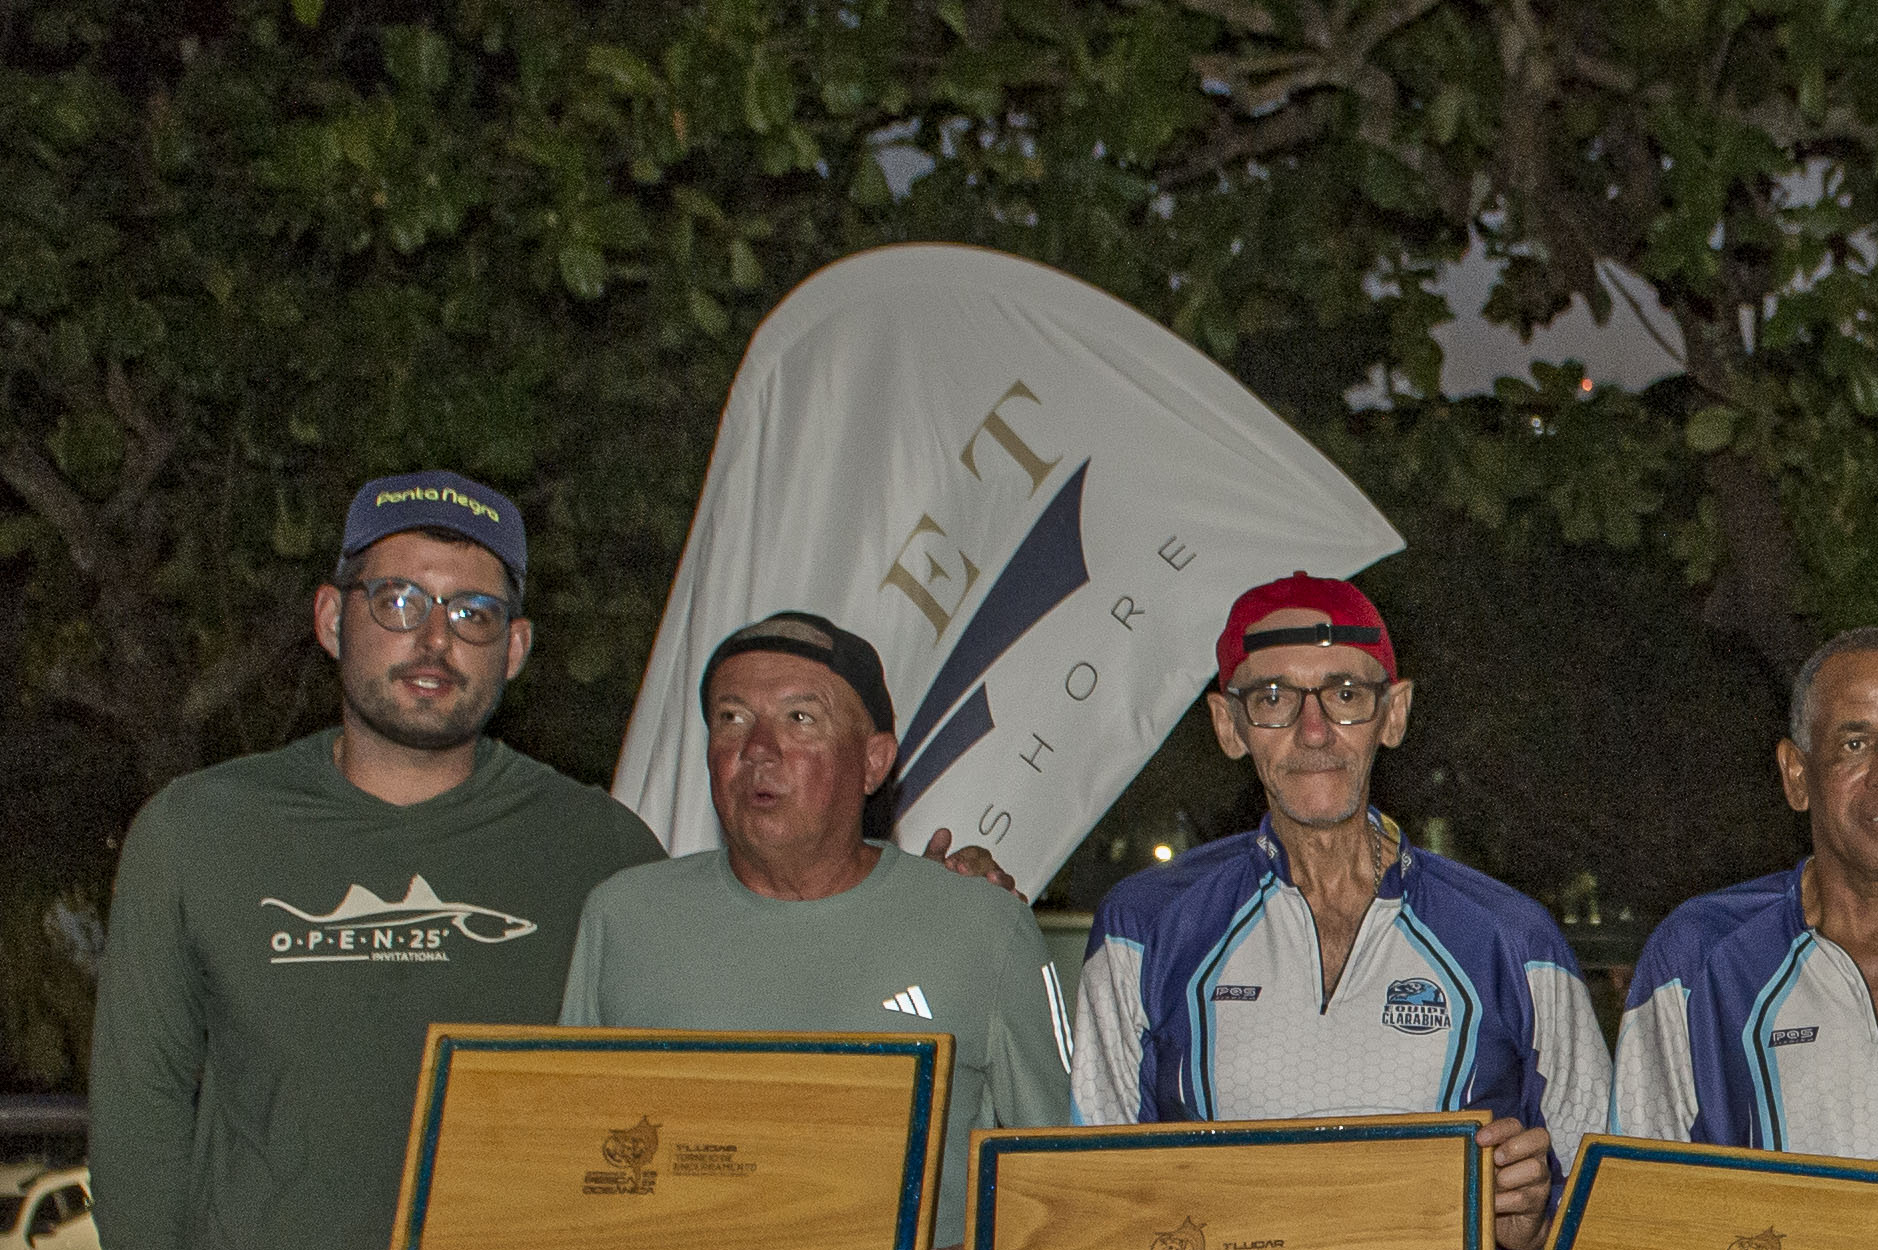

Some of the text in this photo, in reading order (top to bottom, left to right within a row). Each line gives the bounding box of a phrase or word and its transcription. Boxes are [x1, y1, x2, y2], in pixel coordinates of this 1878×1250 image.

[370, 951, 450, 962] INVITATIONAL
[1382, 1012, 1452, 1028] CLARABINA
[1233, 1239, 1285, 1250] LUGAR
